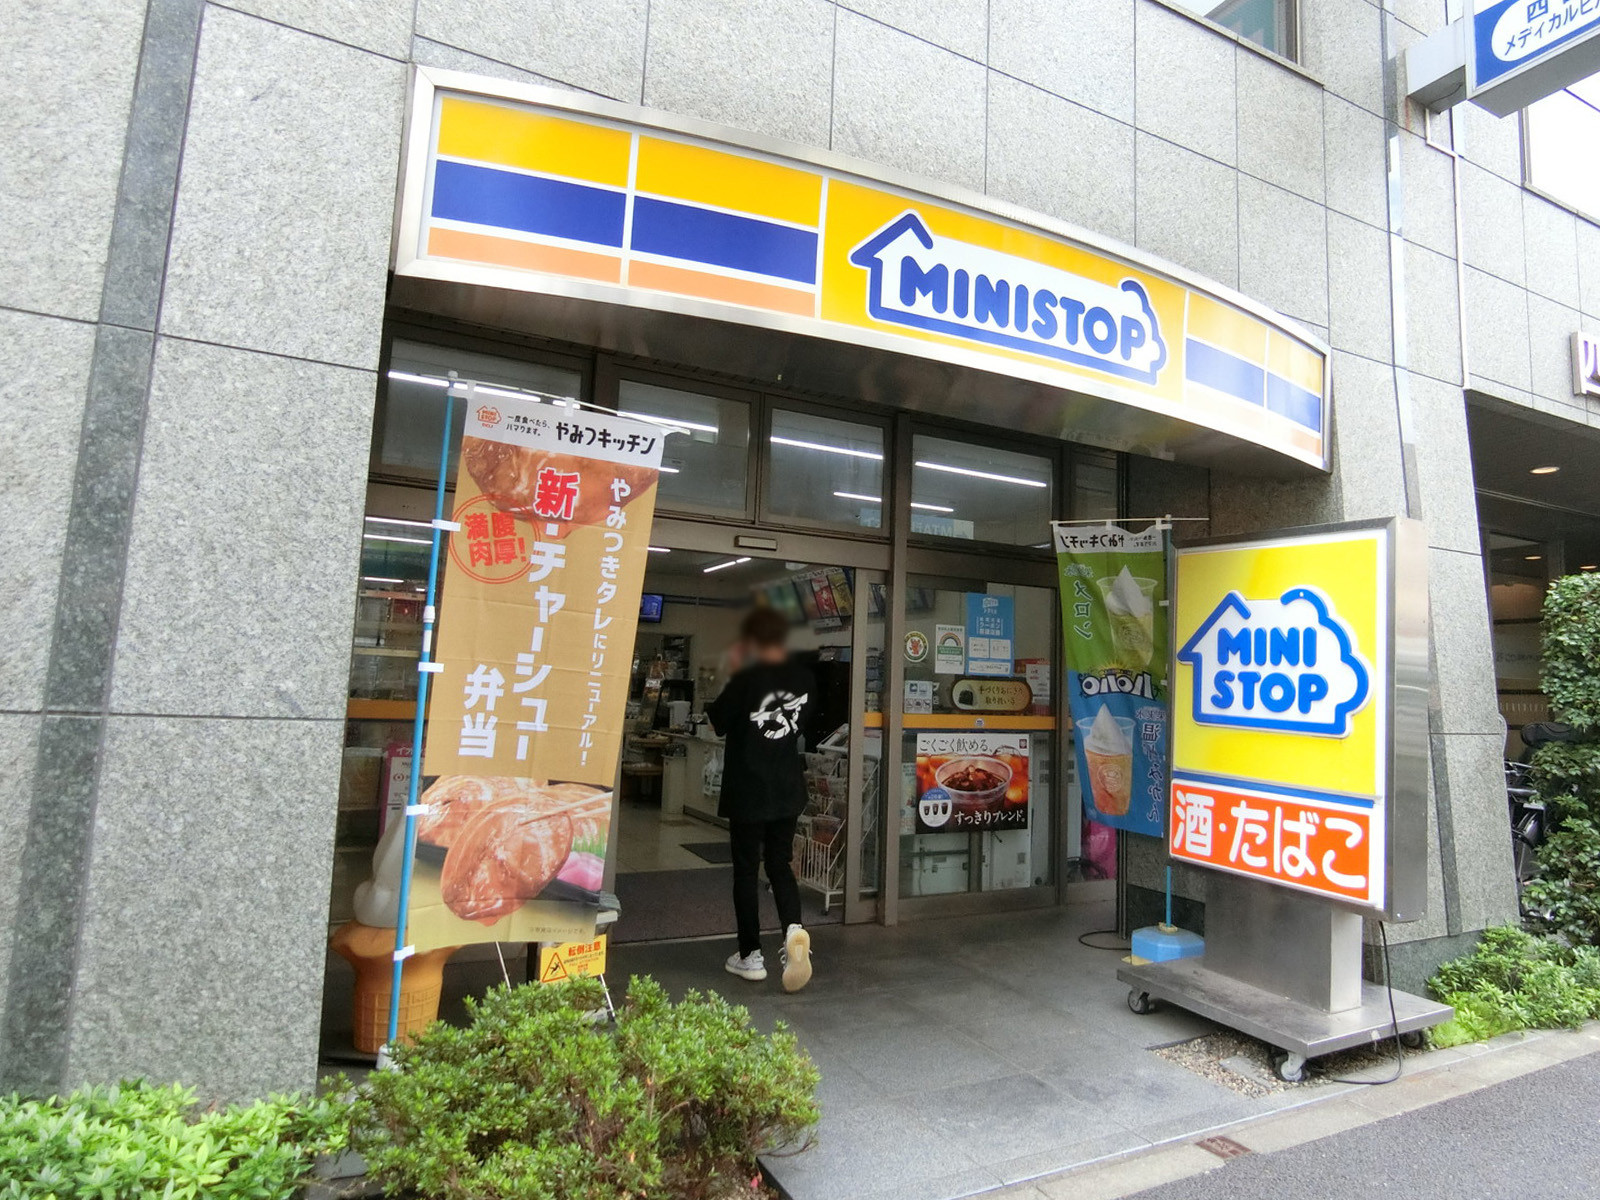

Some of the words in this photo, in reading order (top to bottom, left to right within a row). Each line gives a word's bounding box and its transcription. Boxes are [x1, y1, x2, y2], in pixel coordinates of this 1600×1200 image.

[900, 255, 1146, 361] MINISTOP
[556, 421, 656, 455] やみつキッチン
[464, 512, 517, 541] 満腹
[1217, 626, 1317, 667] MINI
[458, 663, 506, 759] 弁当
[1210, 670, 1329, 714] STOP
[1173, 789, 1366, 888] 酒・たばこ
